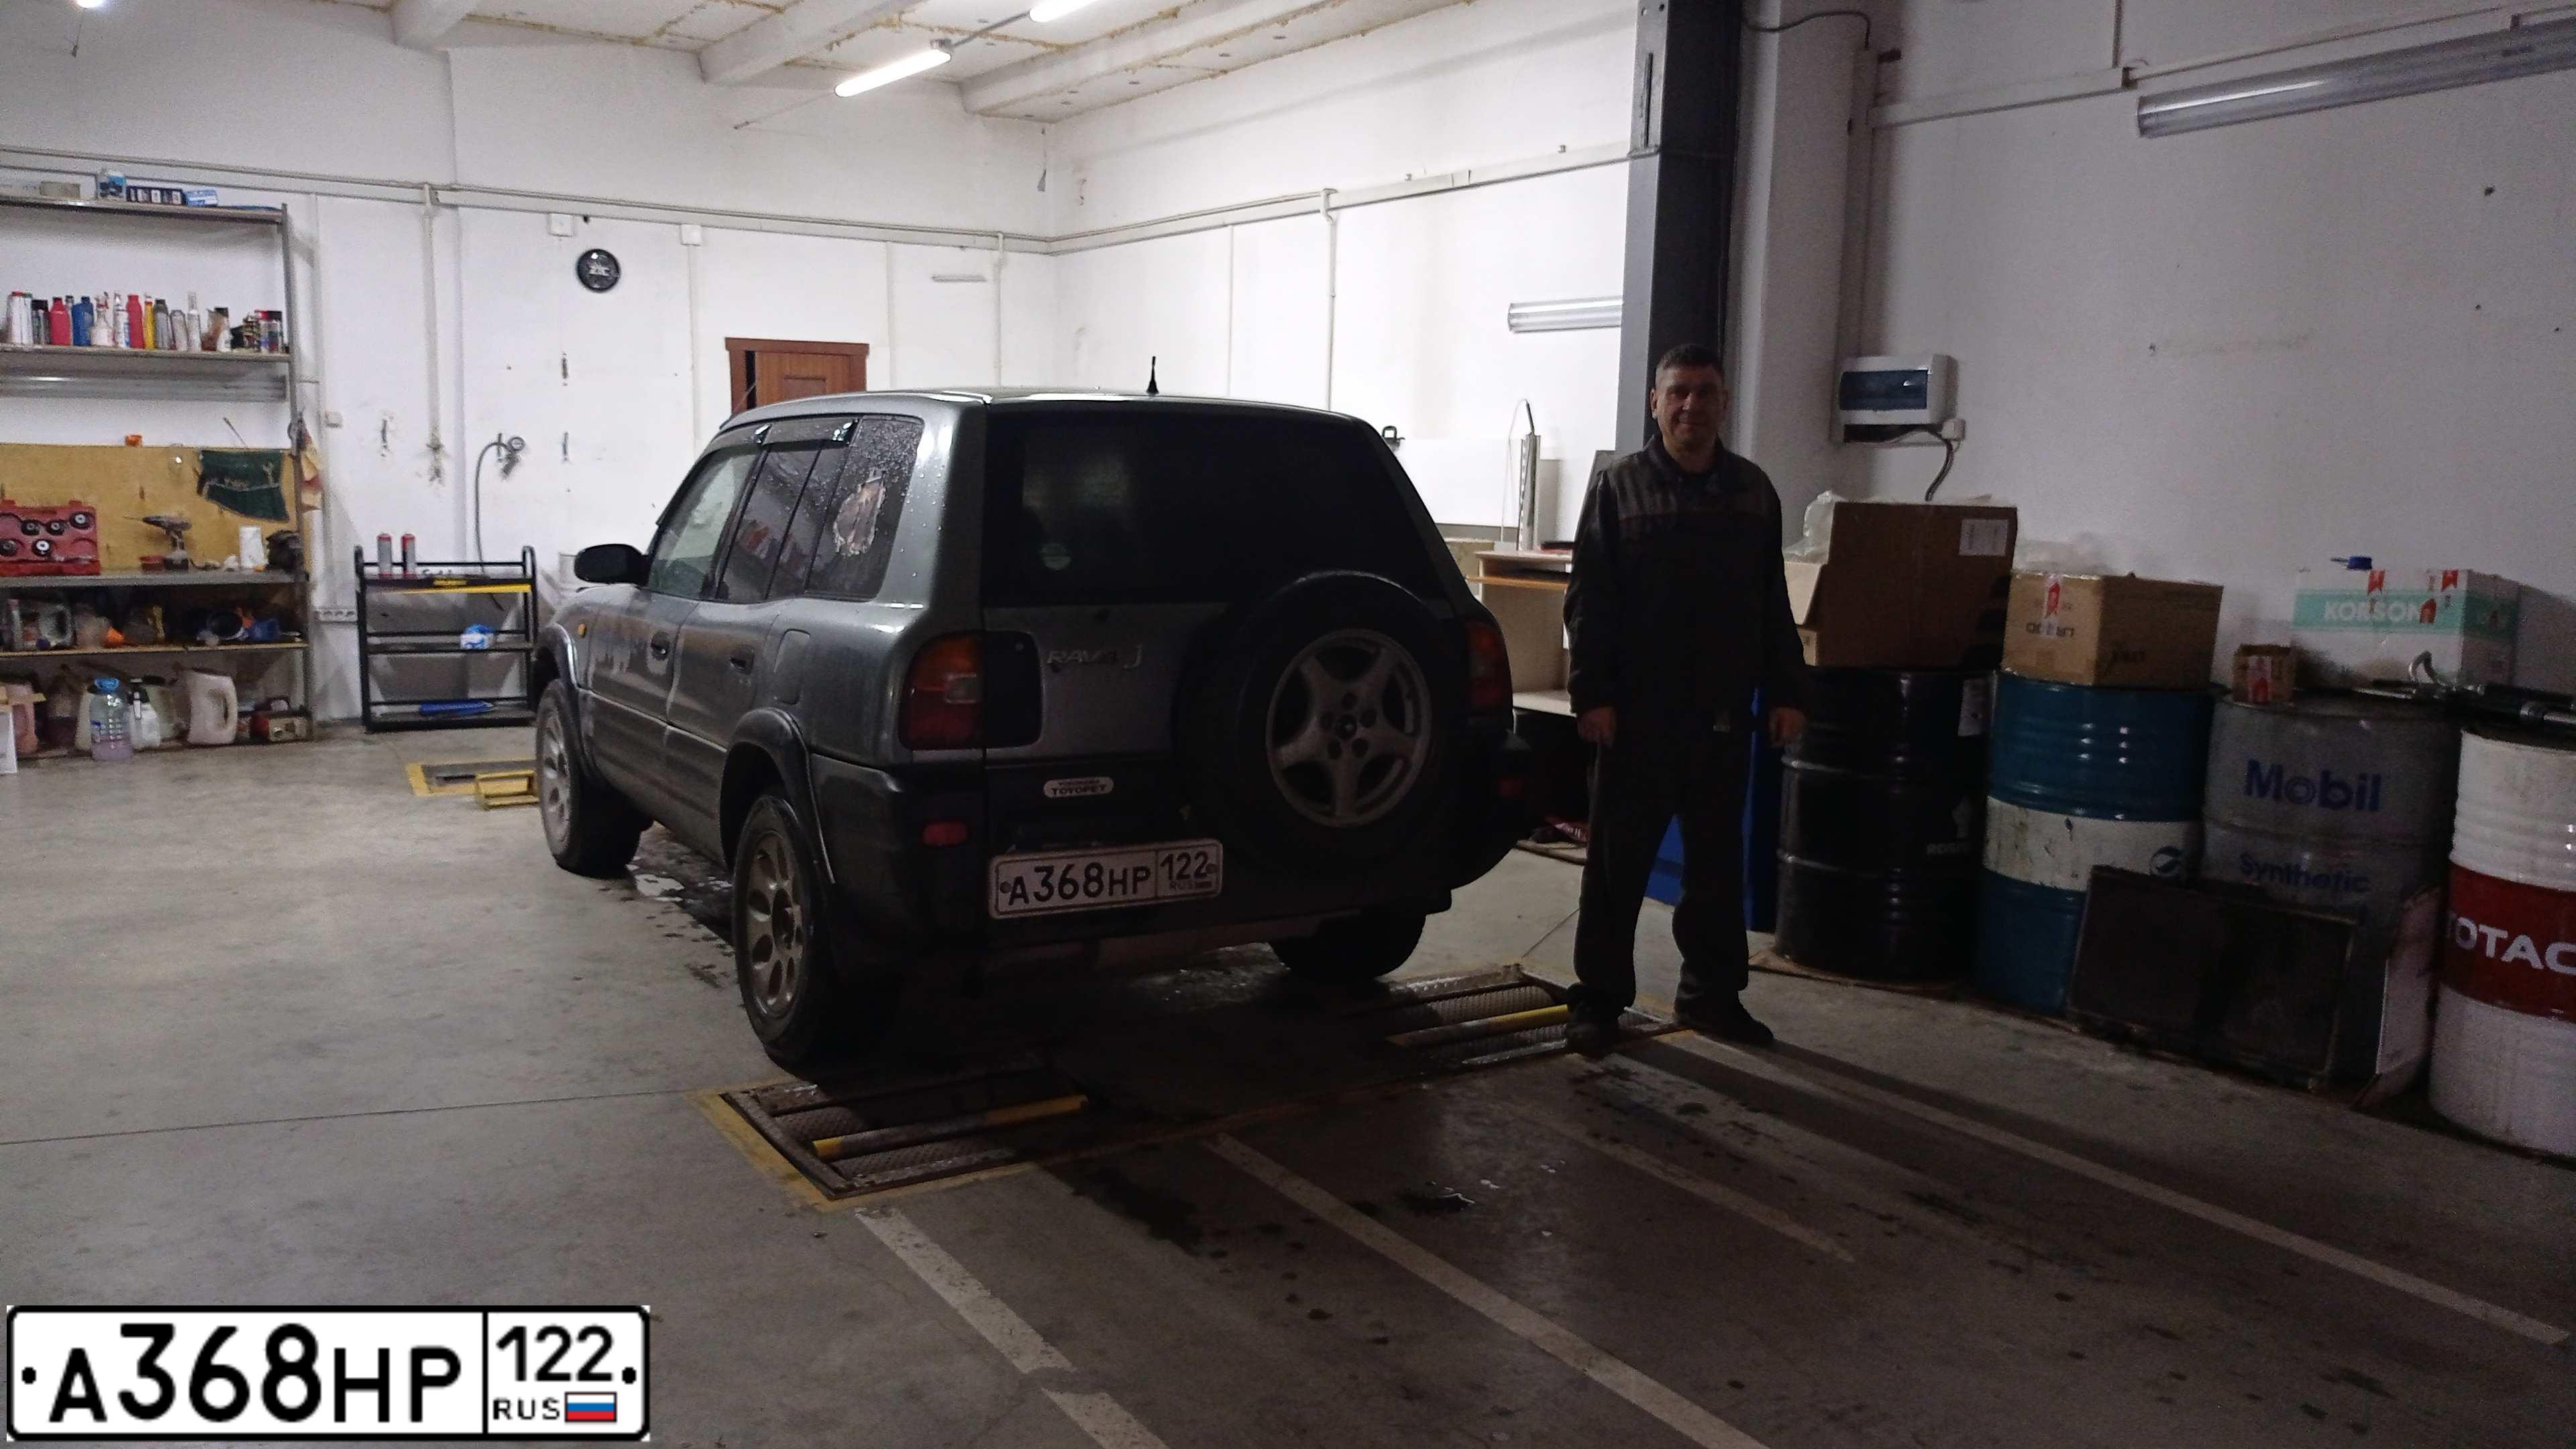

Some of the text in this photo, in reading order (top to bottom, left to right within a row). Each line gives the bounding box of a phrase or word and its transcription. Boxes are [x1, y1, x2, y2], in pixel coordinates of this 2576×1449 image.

[1051, 784, 1107, 796] TOYOPET
[2243, 759, 2381, 812] Mobil
[1160, 851, 1210, 881] 122
[2239, 852, 2372, 893] Synthetic
